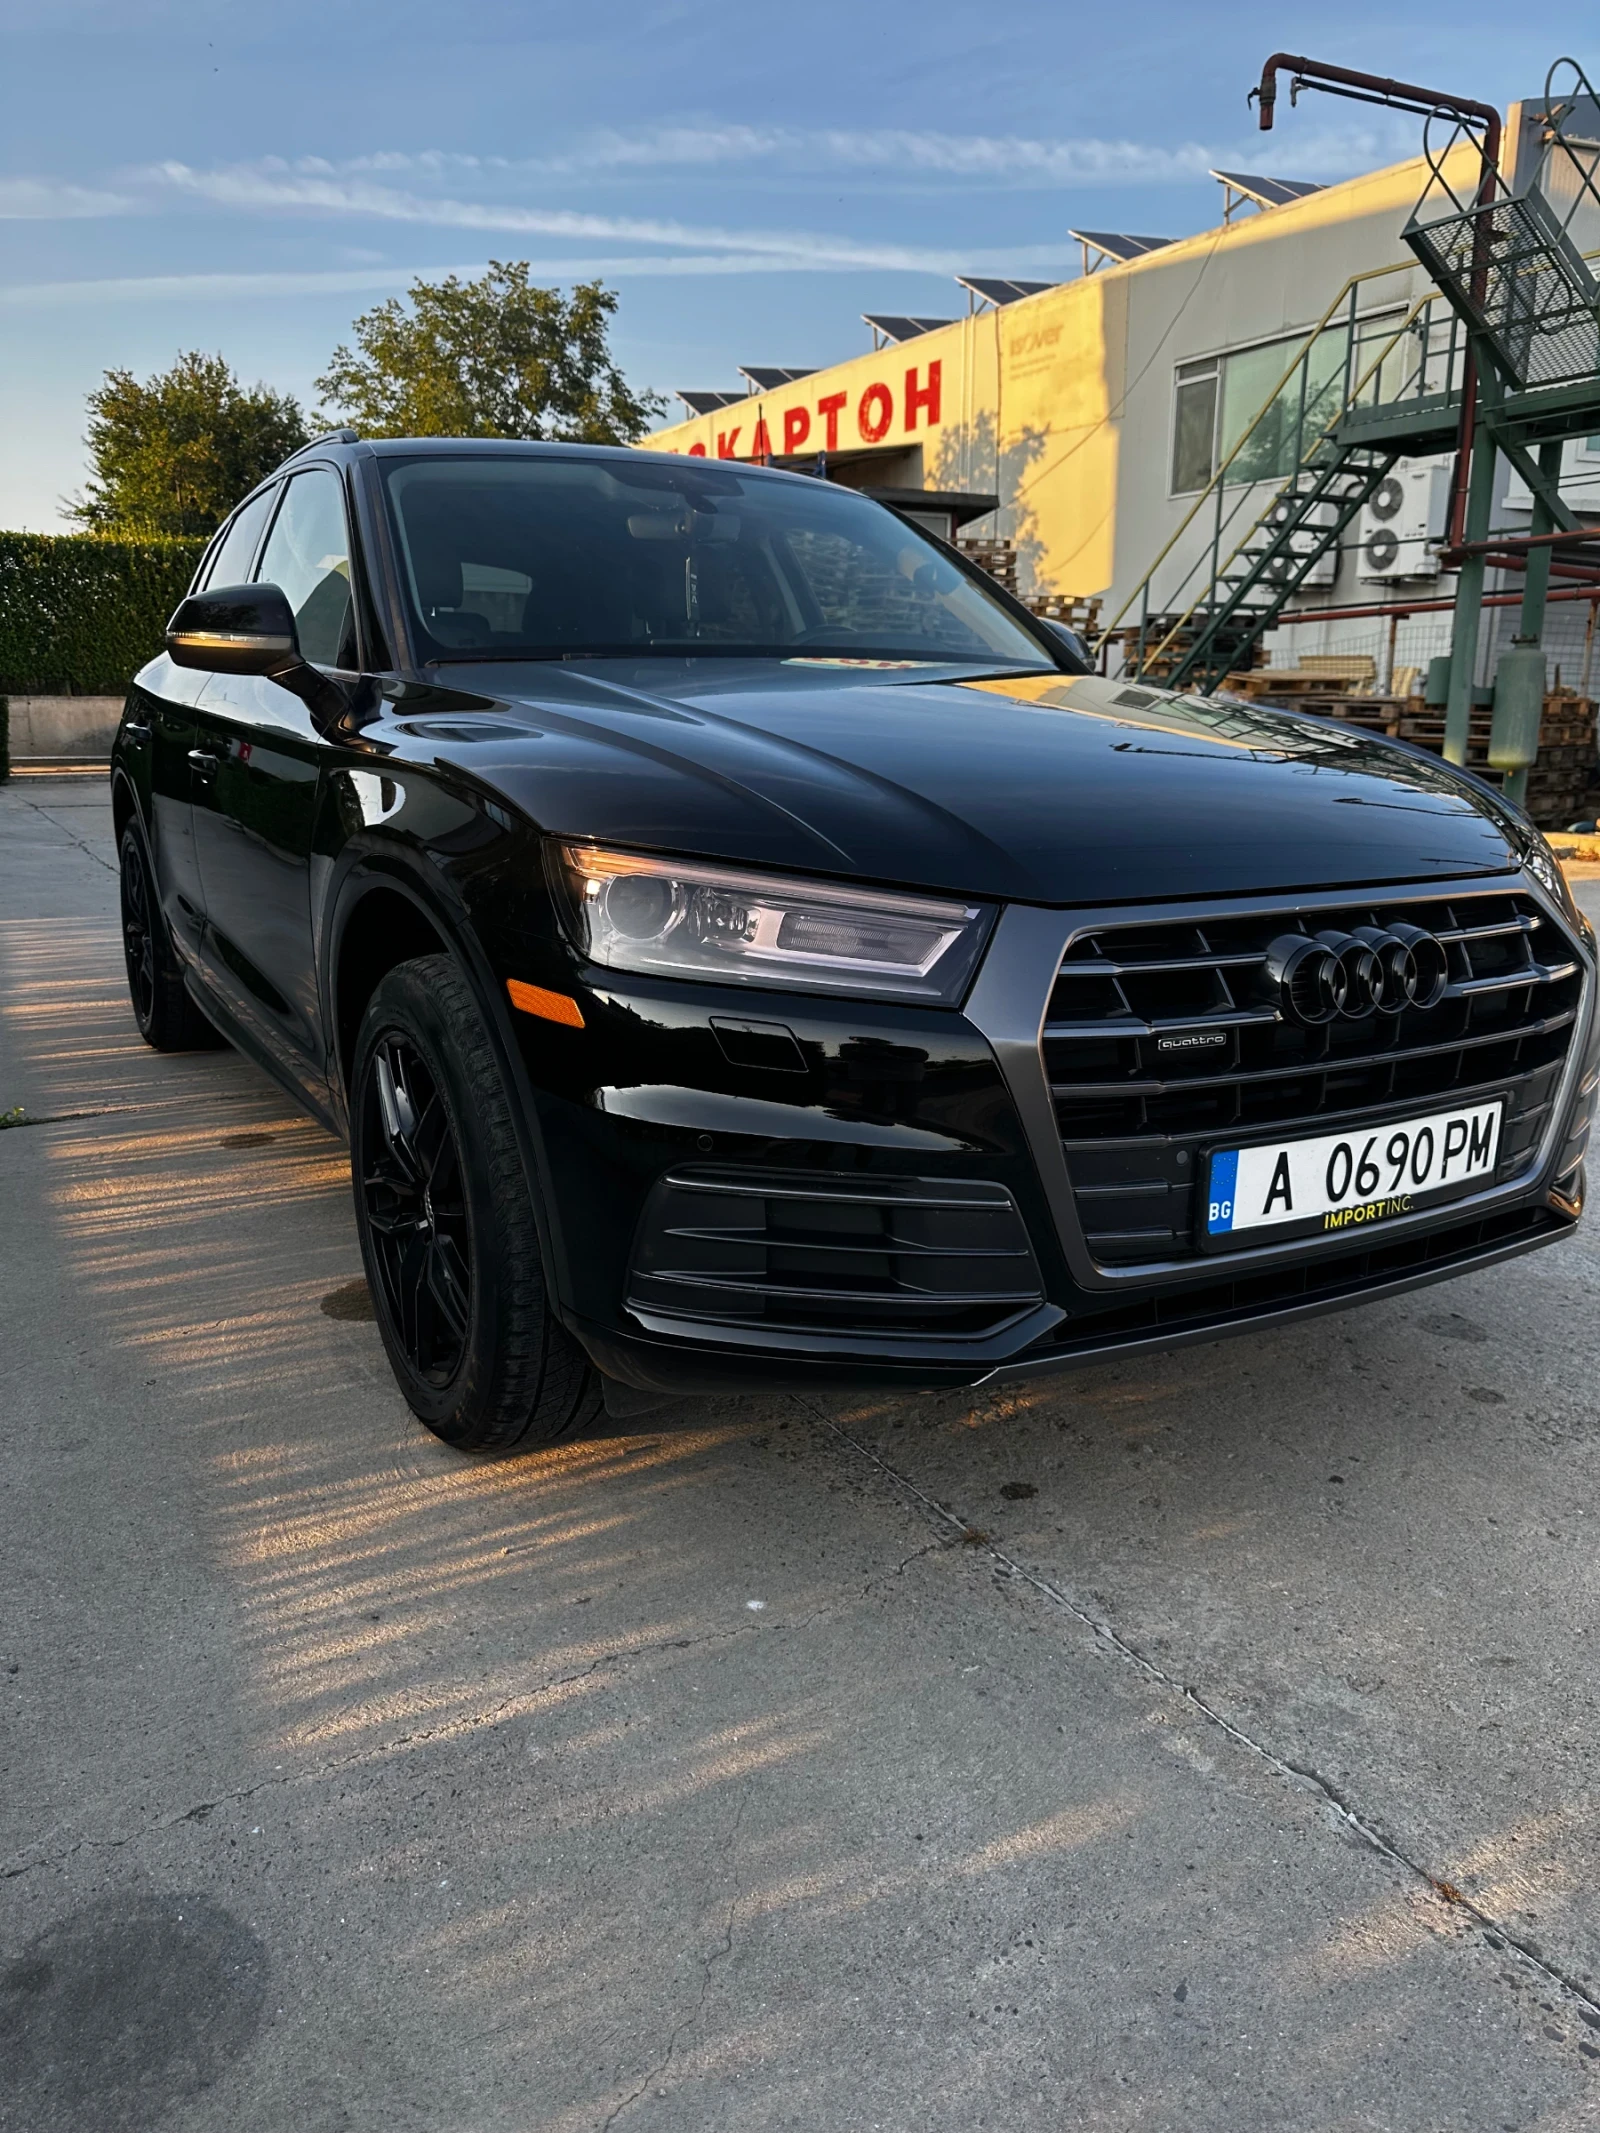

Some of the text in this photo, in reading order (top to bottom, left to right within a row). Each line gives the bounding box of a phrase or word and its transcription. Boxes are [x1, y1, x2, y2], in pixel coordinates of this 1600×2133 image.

[668, 359, 942, 466] КАРТОН
[1162, 1036, 1224, 1049] quattro
[1262, 1111, 1495, 1215] A 0690 PM
[1209, 1202, 1231, 1221] BG
